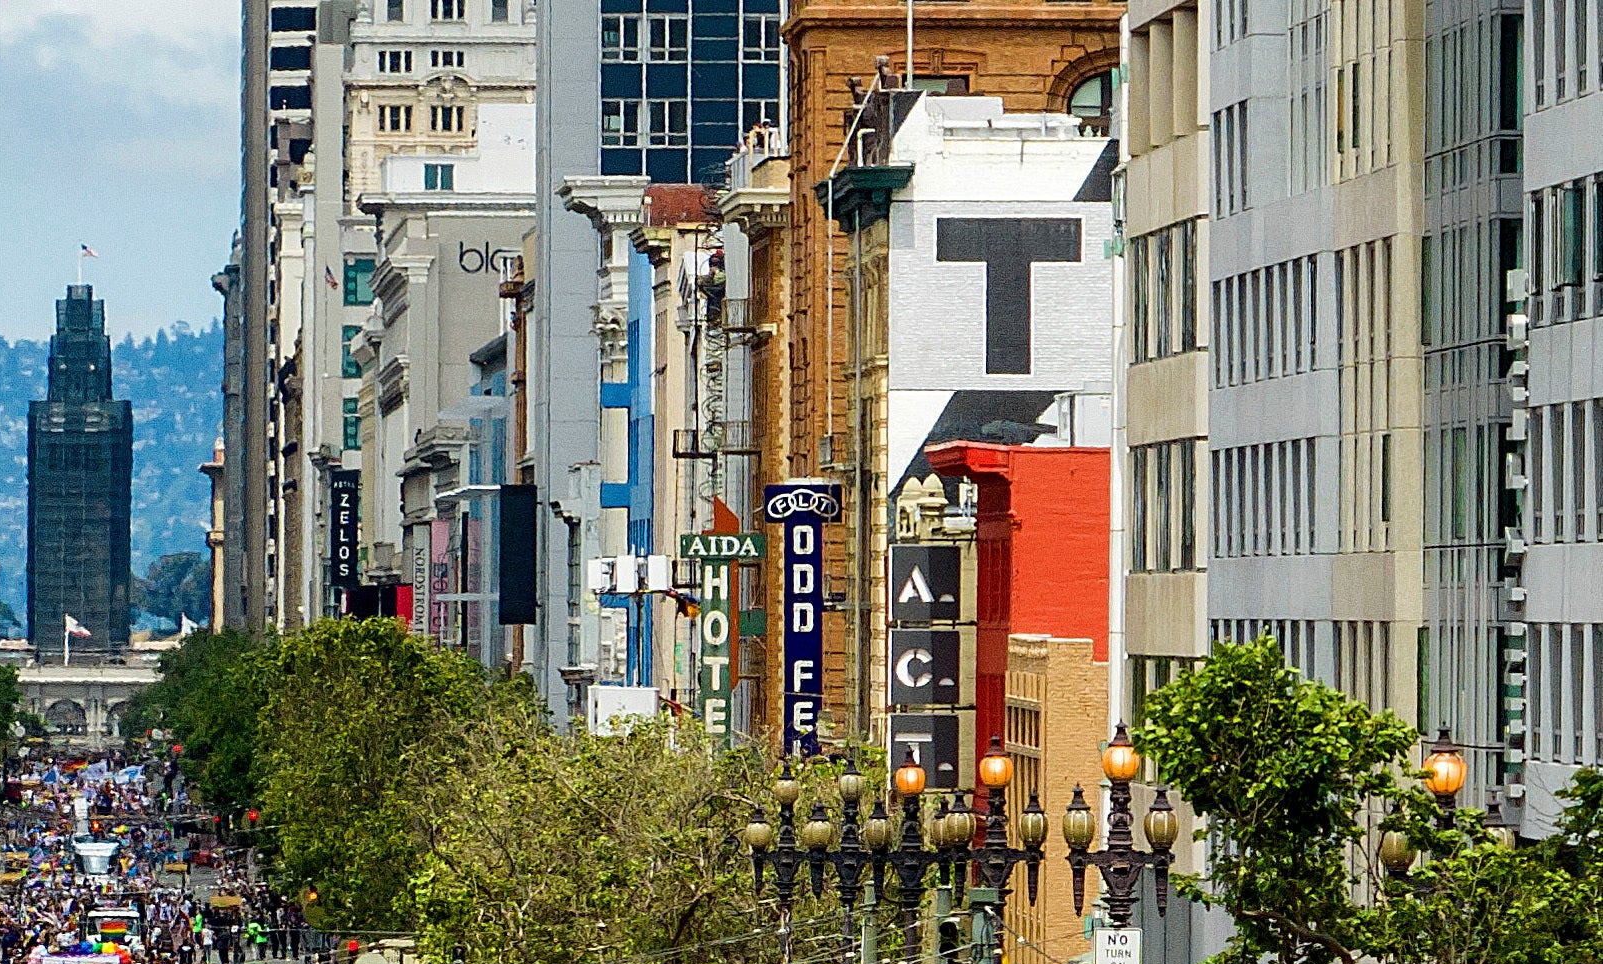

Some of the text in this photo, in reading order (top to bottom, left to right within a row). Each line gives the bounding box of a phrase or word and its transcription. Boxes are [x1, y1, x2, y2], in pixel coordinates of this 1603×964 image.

[936, 216, 1082, 375] T
[339, 494, 350, 577] ZELOS
[792, 525, 814, 633] ODD
[703, 564, 730, 734] HOTE
[1106, 949, 1132, 958] TURN
[1108, 935, 1128, 945] NO
